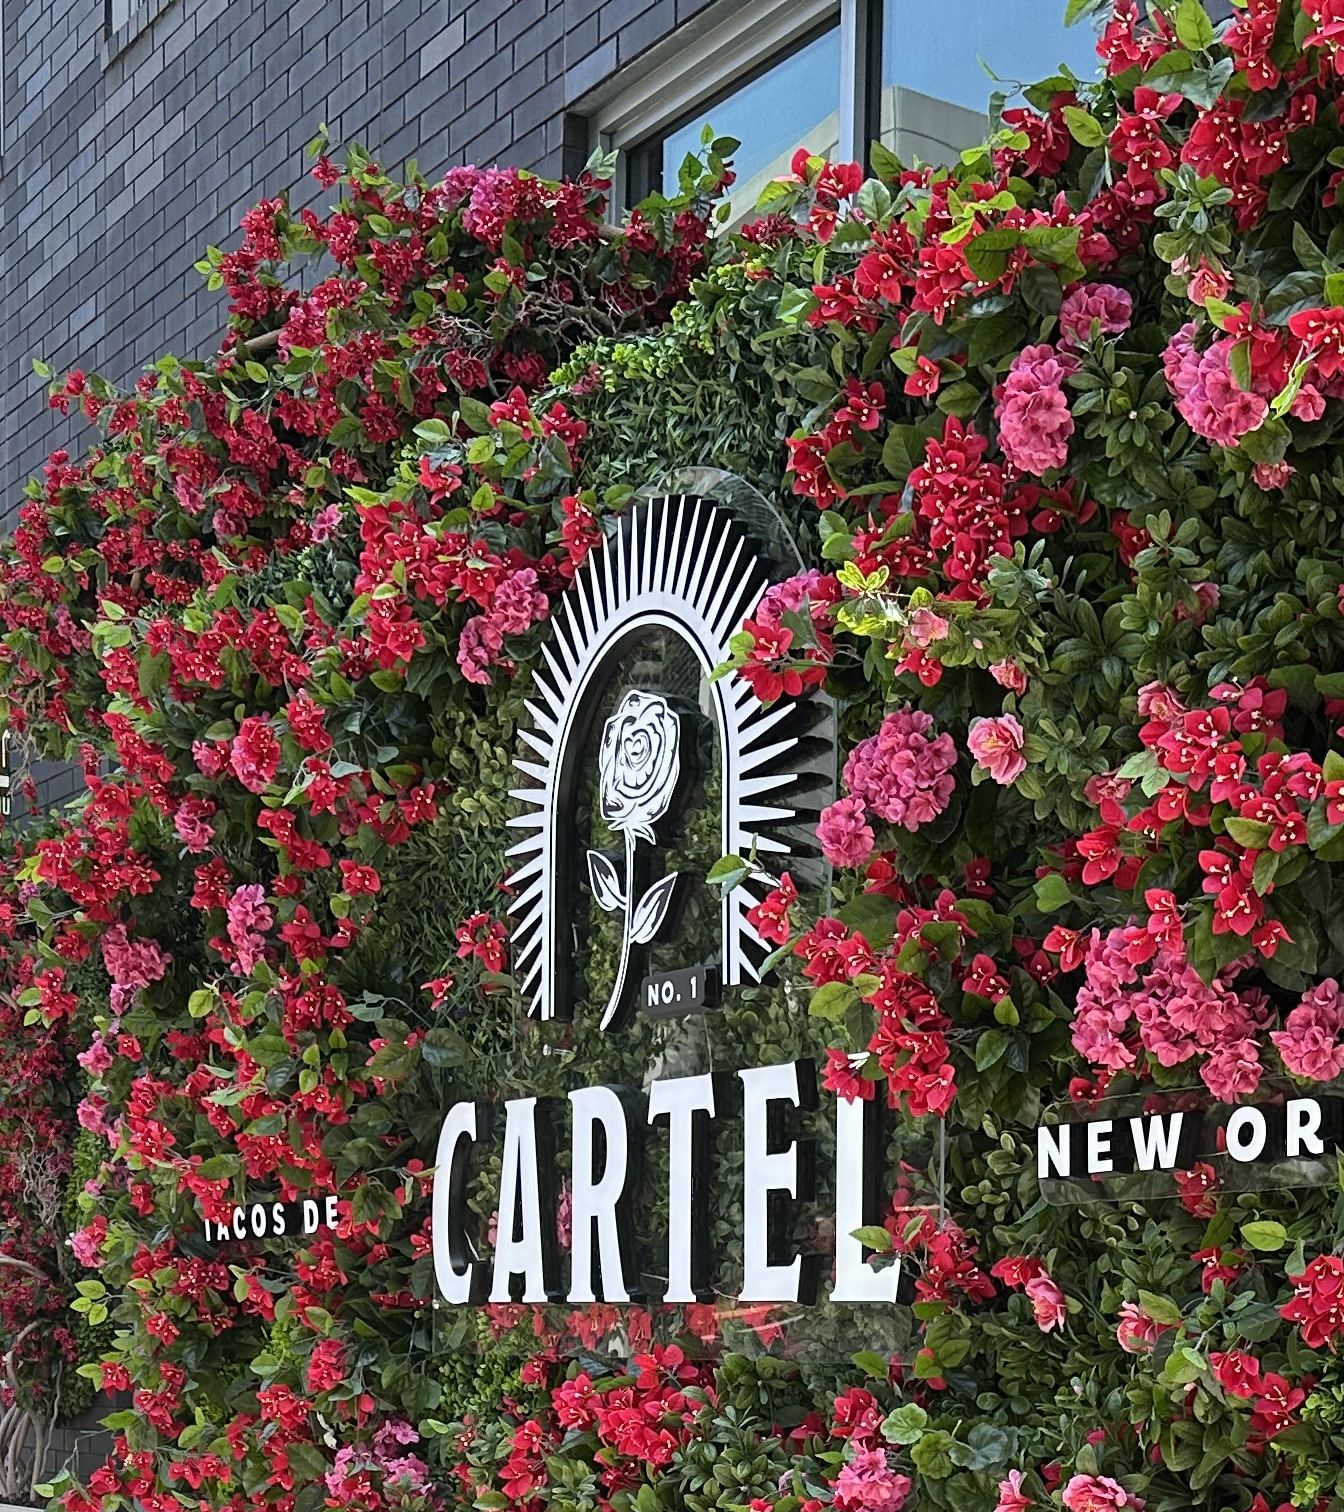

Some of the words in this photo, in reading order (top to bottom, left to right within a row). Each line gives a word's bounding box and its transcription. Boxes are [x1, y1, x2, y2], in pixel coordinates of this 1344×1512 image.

[647, 980, 681, 1007] NO.
[690, 976, 697, 999] 1
[1037, 1112, 1184, 1179] NEW
[432, 1060, 902, 1304] CARTEL
[303, 1195, 339, 1234] DE
